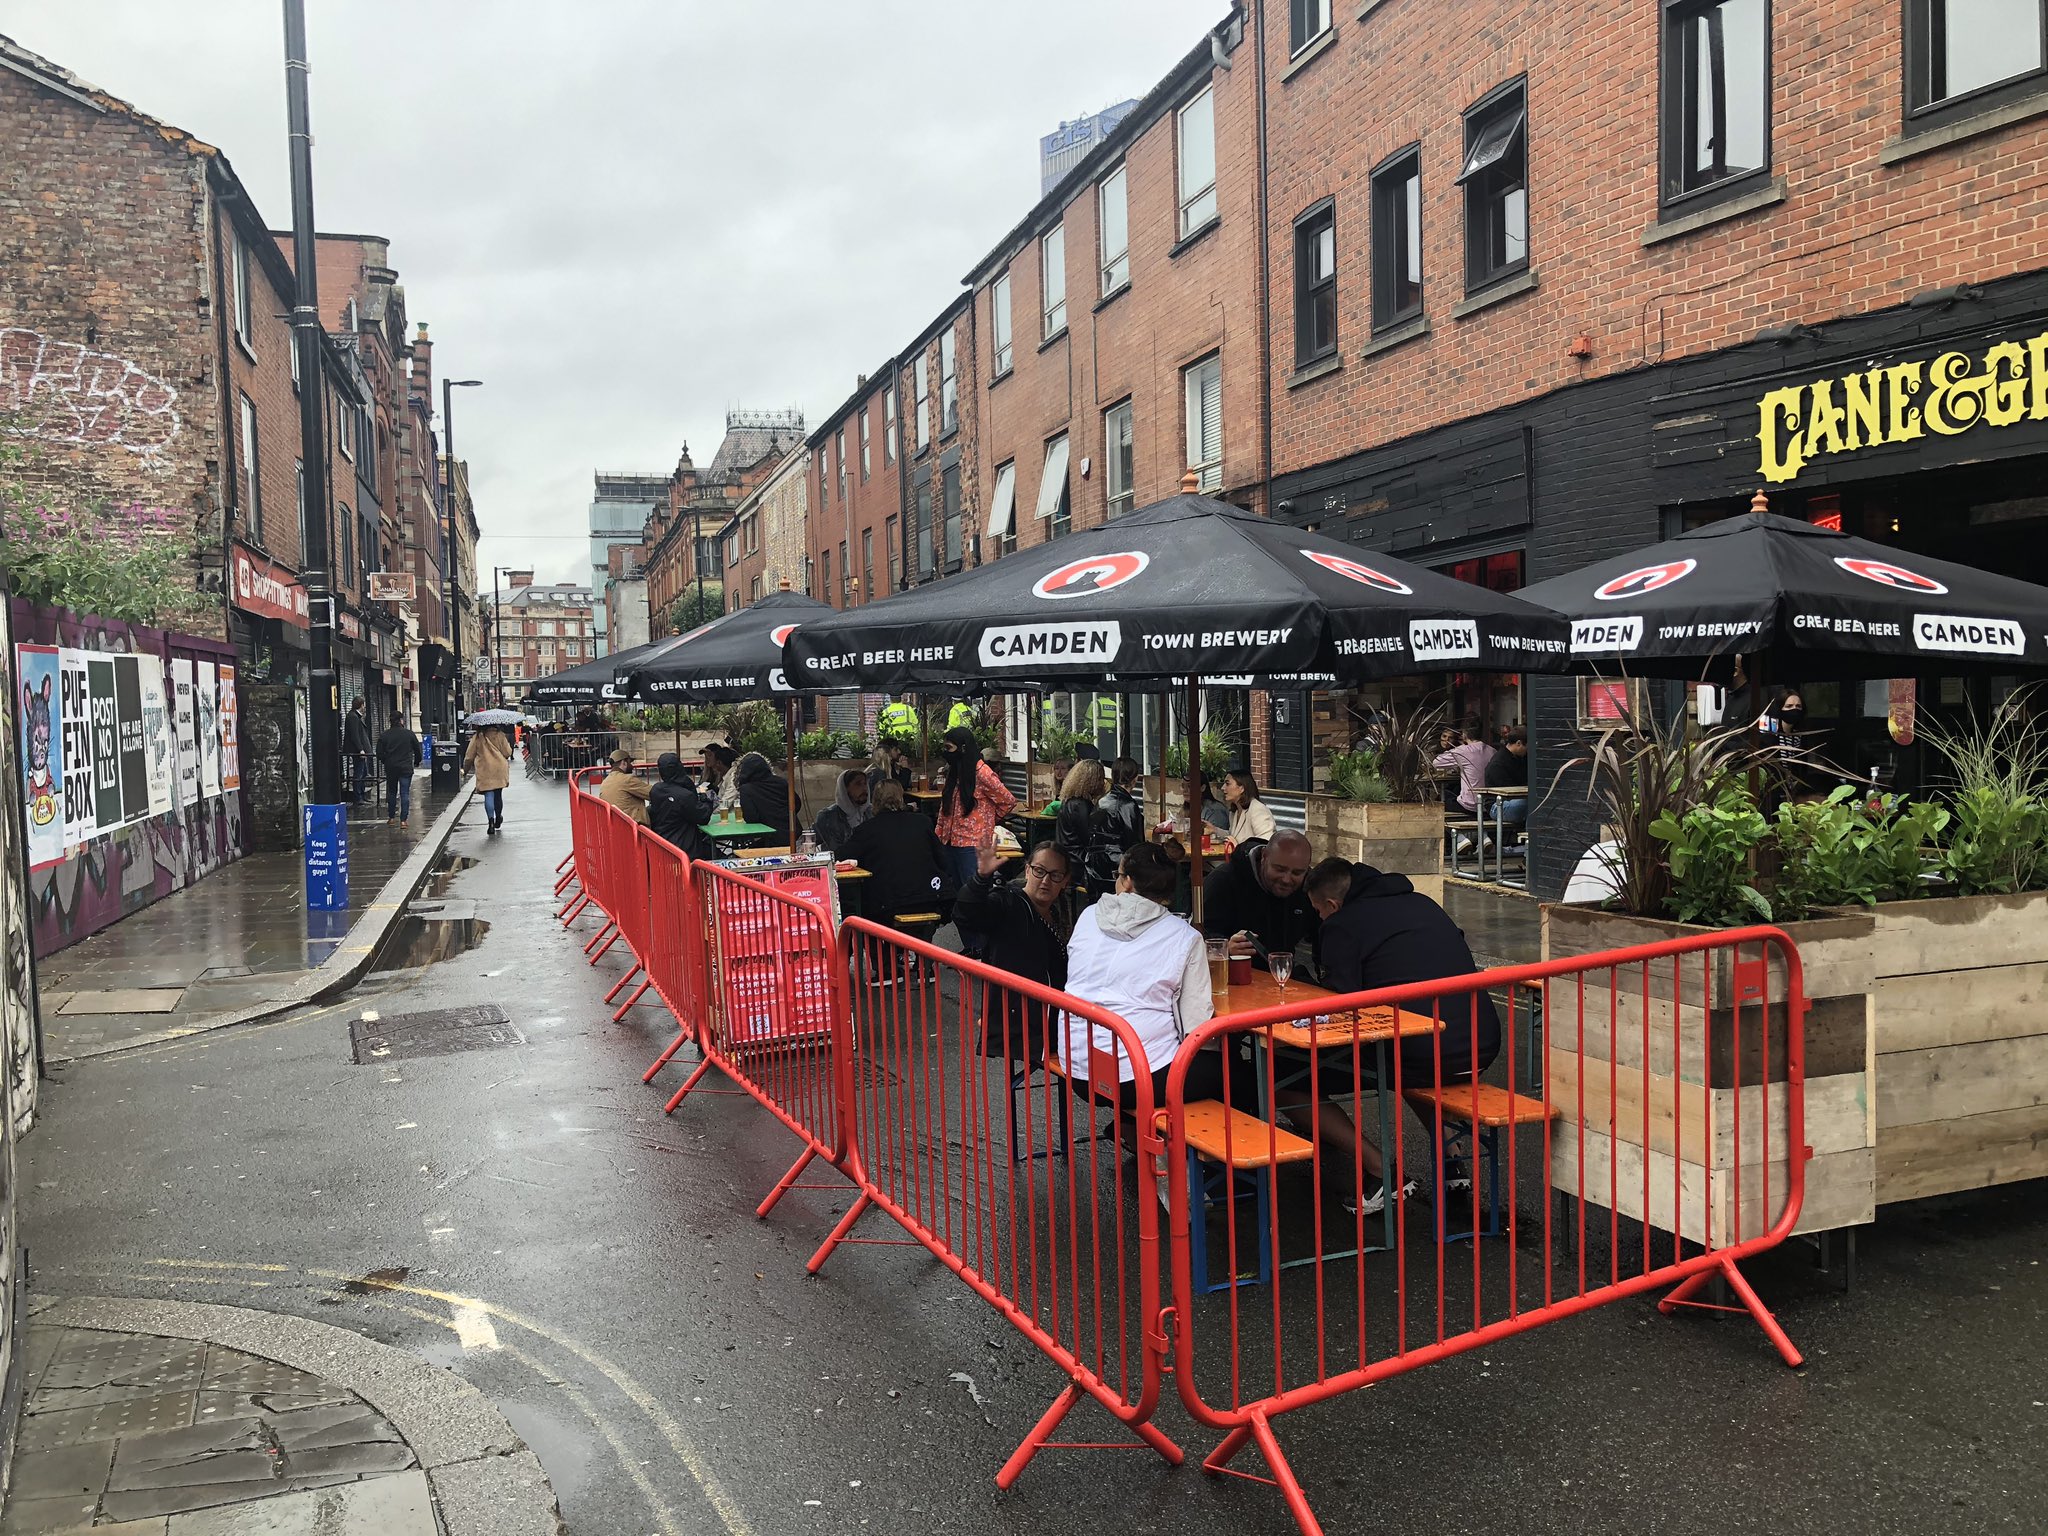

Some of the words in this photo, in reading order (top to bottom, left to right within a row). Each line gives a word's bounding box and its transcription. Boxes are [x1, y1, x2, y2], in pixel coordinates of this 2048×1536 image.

[1142, 633, 1194, 649] TOWN
[1201, 628, 1293, 648] BREWERY
[1575, 624, 1634, 644] MDEN
[1659, 625, 1693, 640] TOWN
[1697, 621, 1762, 636] BREWERY
[1869, 622, 1900, 636] HERE
[1920, 622, 2015, 646] CAMDEN
[990, 631, 1108, 657] CAMDEN
[1413, 629, 1473, 651] CAMDEN
[1488, 635, 1520, 649] TOWN
[1521, 638, 1567, 654] BREWERY
[806, 653, 857, 670] GREAT
[863, 650, 905, 665] BEER
[911, 646, 954, 662] HERE
[61, 670, 87, 718] PUF
[176, 683, 190, 696] NEVER
[650, 680, 689, 692] GREAT
[692, 679, 723, 690] BEER
[726, 677, 755, 688] HERE
[92, 697, 114, 727] POST
[121, 722, 131, 737] WE
[131, 719, 142, 734] ARE
[63, 721, 91, 771] FIN
[99, 728, 113, 758] NO
[122, 736, 143, 753] ALLONE
[222, 746, 240, 777] BOX
[99, 760, 116, 791] ILLS
[65, 771, 94, 824] BOX
[311, 840, 327, 849] Keep
[308, 858, 332, 866] distance
[312, 868, 328, 877] guys!
